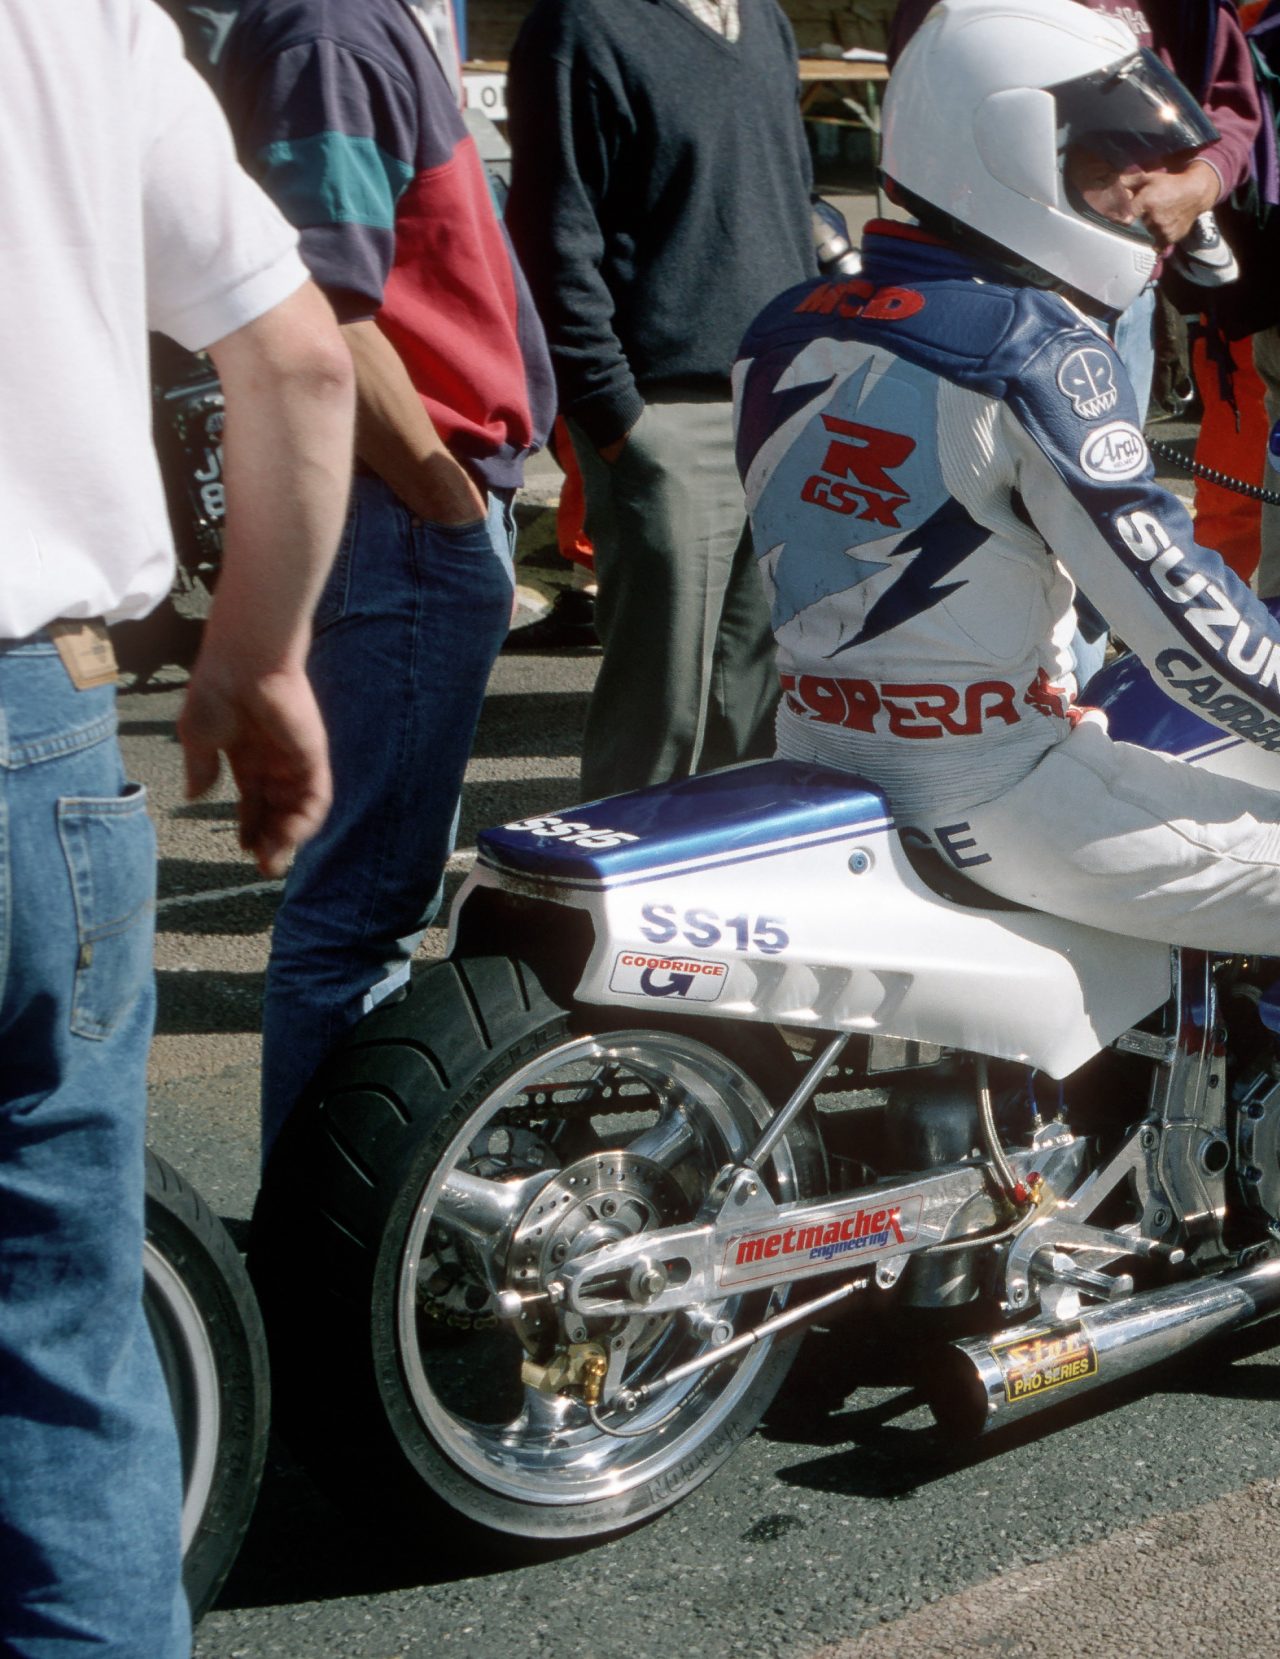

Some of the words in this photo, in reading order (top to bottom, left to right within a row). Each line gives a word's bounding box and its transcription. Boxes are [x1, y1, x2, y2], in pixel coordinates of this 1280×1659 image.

[819, 413, 917, 498] R
[1096, 433, 1139, 466] Arai
[801, 475, 911, 528] GSX
[504, 817, 641, 848] SS15
[640, 903, 790, 954] SS15
[621, 955, 724, 977] GOODRIDGE
[735, 1205, 905, 1265] metmachex
[809, 1231, 889, 1260] engineering
[1044, 1357, 1089, 1385] SERIES
